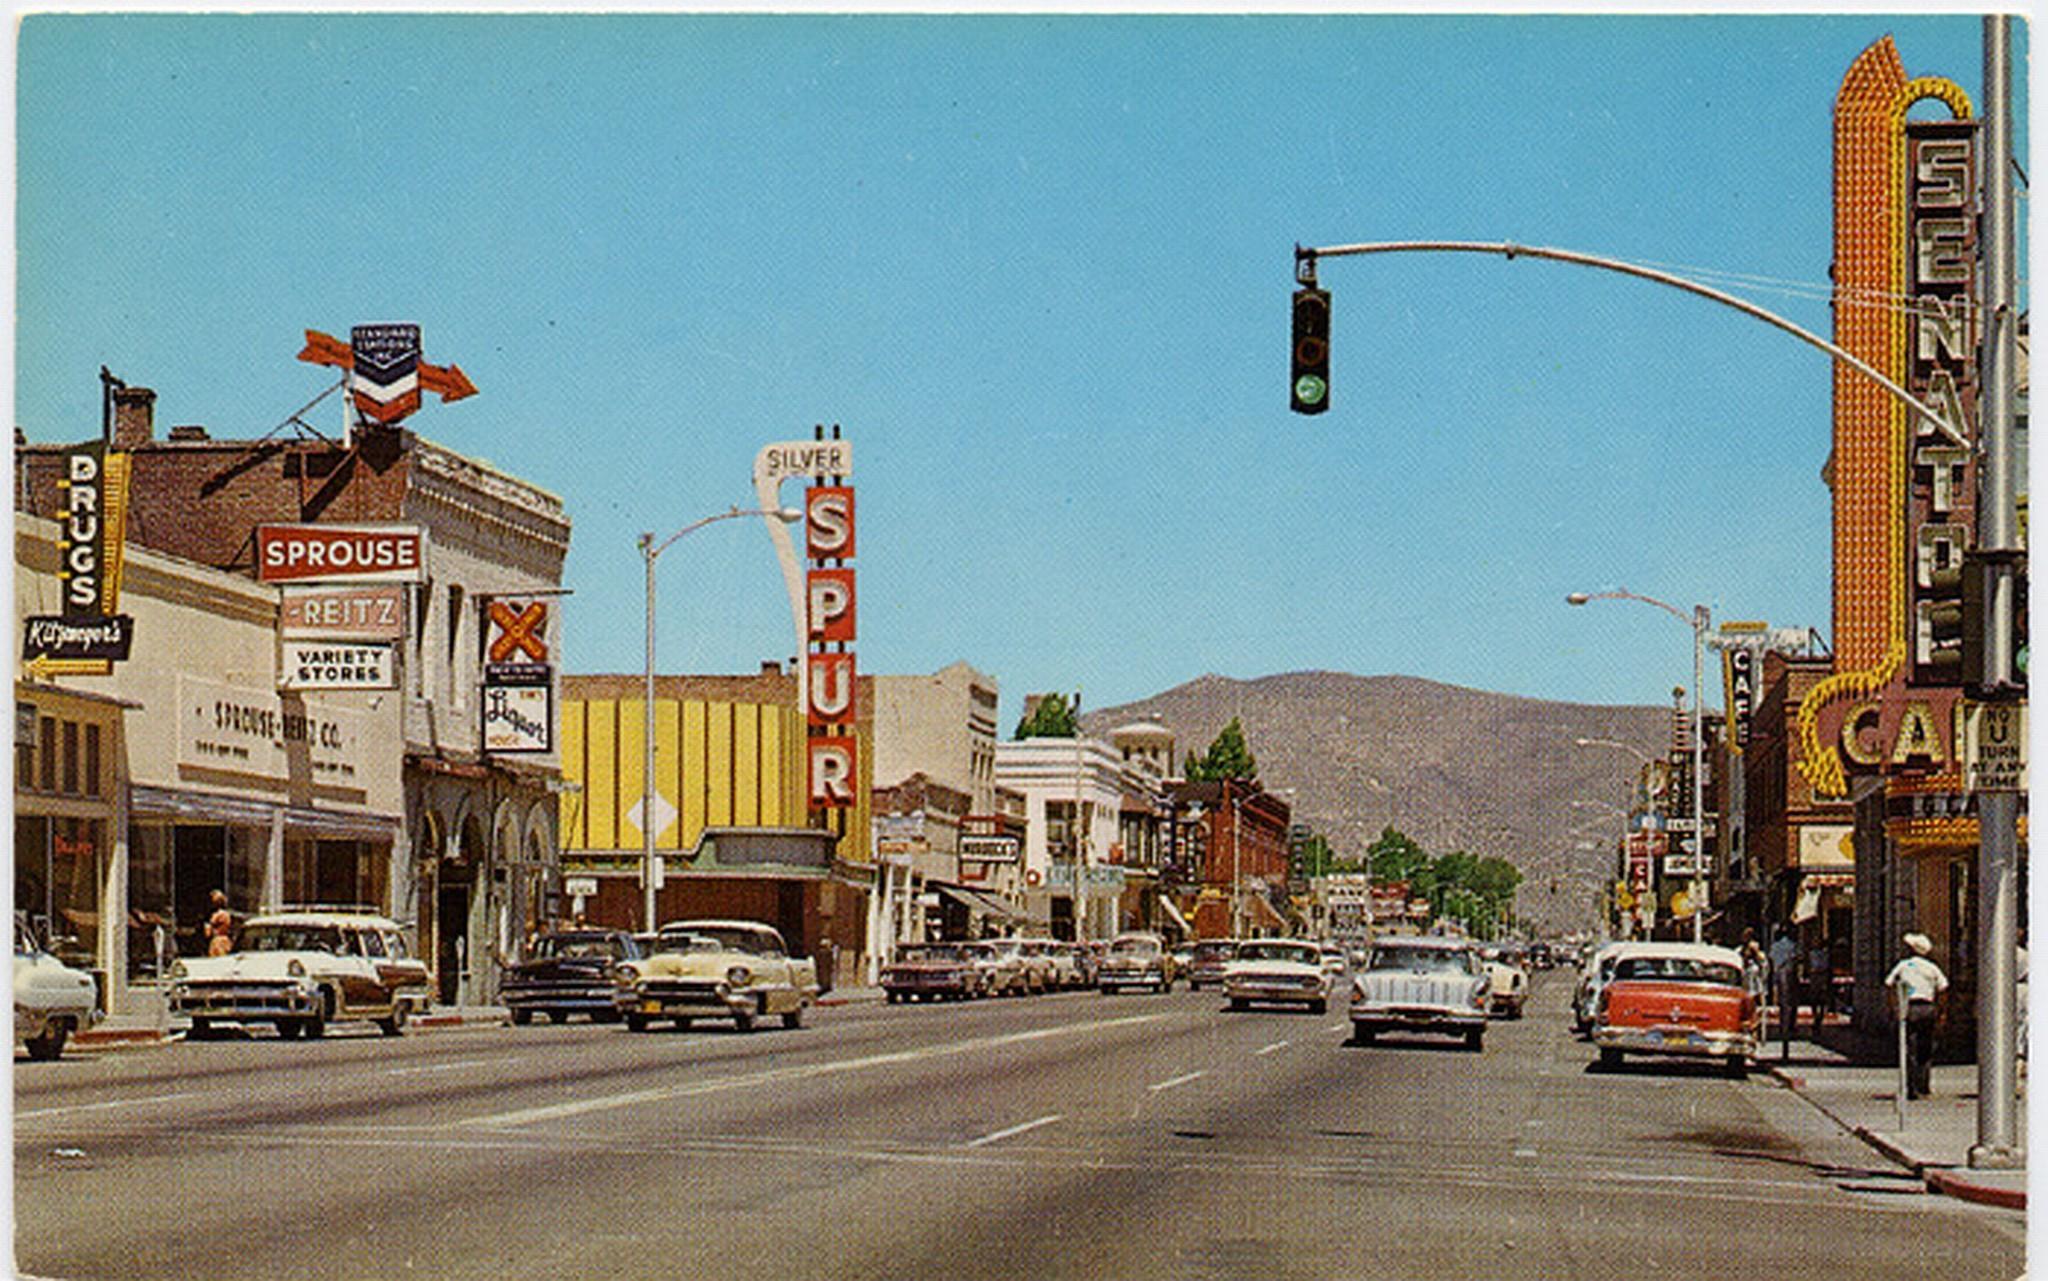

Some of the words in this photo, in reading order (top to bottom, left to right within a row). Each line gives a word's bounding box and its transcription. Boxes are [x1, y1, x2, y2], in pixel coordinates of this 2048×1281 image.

[767, 449, 842, 470] SILVER
[69, 455, 97, 606] DRUGS
[266, 540, 415, 566] SPROUSE
[808, 492, 853, 800] SPUR
[297, 651, 382, 664] VARIETY
[298, 667, 380, 681] STORES
[1733, 651, 1751, 744] CAFE
[486, 689, 546, 744] Liquor
[1987, 710, 2009, 722] NO
[1989, 724, 2007, 743] U
[1979, 746, 2019, 758] TURN
